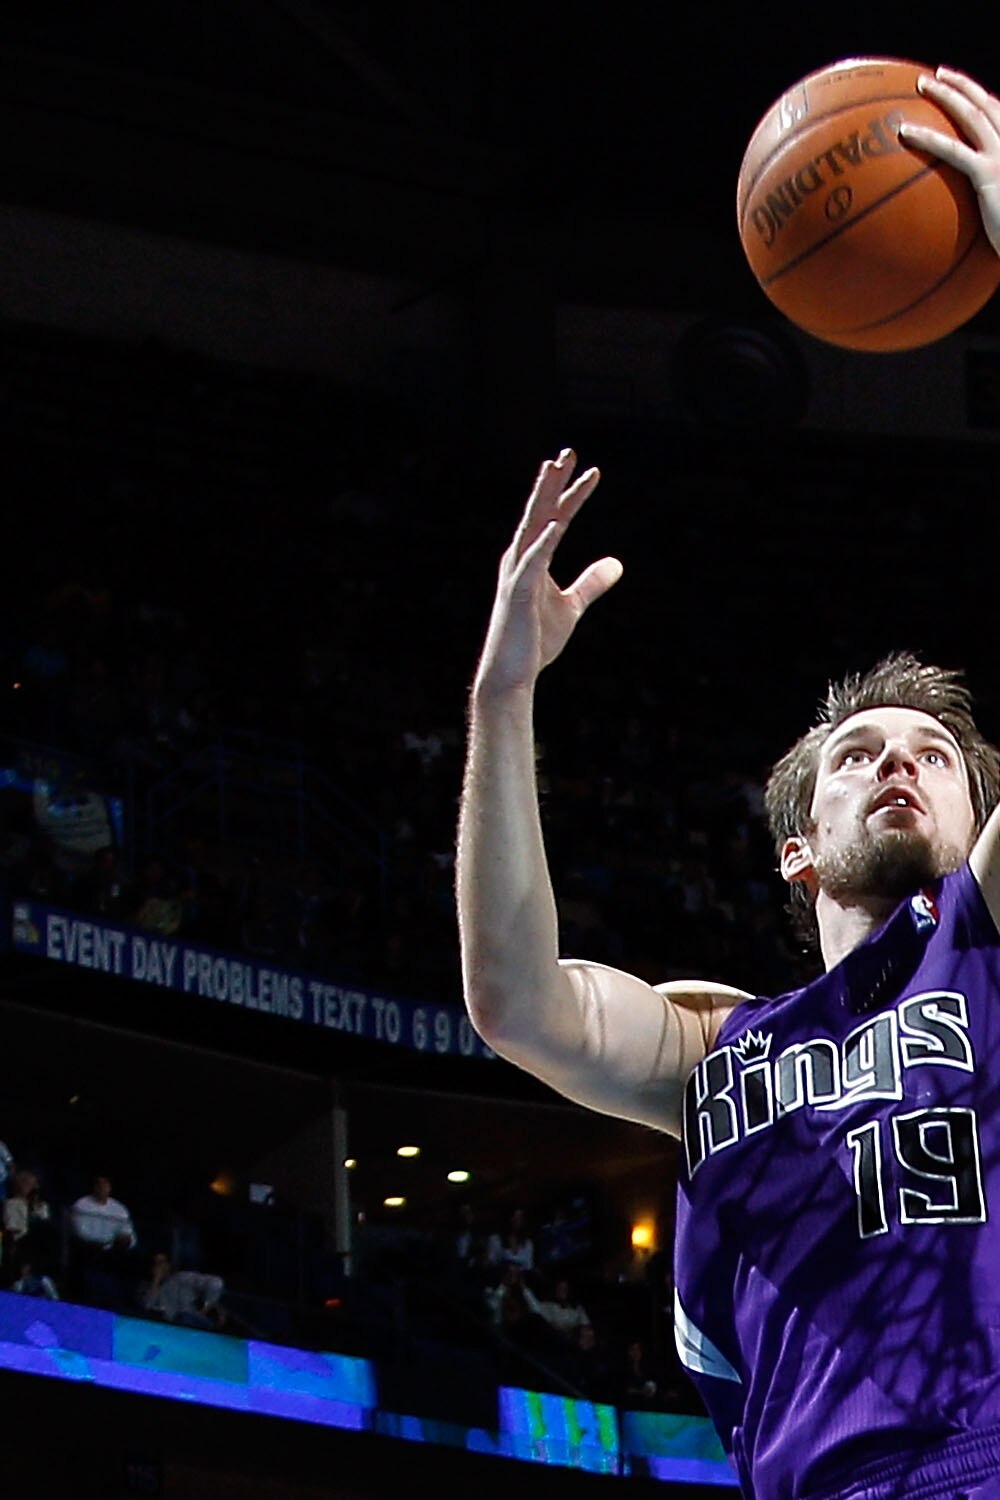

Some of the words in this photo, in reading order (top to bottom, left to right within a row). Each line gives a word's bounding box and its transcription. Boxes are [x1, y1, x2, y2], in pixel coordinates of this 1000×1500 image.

[751, 110, 905, 248] SPALDING
[46, 915, 127, 975] EVENT
[131, 937, 179, 988] DAY
[183, 951, 304, 1021] PROBLEMS
[309, 982, 368, 1035] TEXT
[372, 997, 401, 1044] TO
[682, 992, 975, 1181] Kings
[846, 1108, 987, 1239] 19
